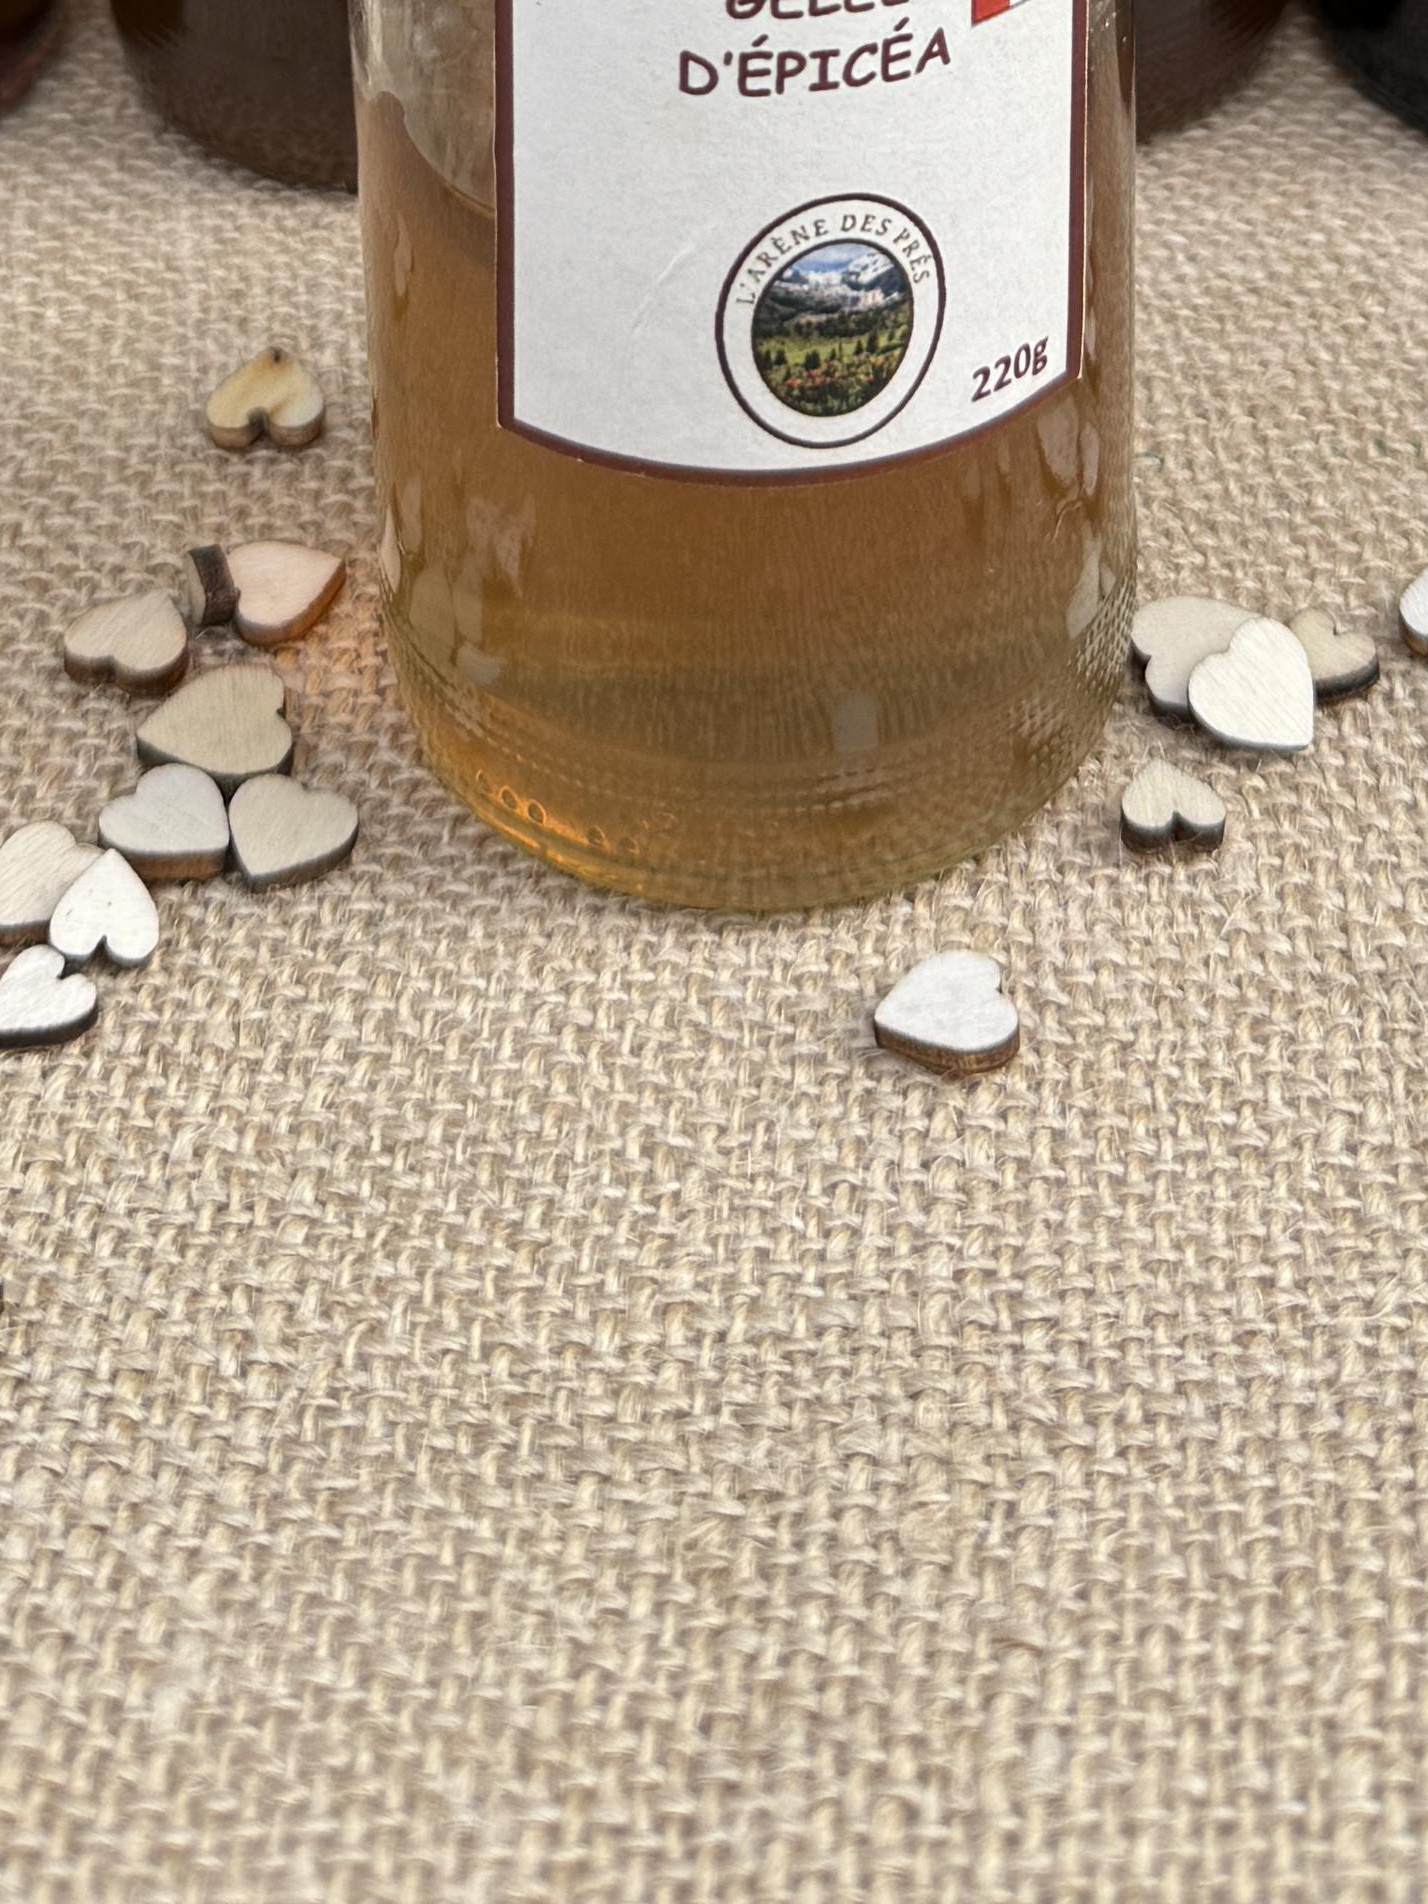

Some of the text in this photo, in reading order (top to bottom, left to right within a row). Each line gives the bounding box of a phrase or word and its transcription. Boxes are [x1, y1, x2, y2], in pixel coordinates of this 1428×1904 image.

[678, 18, 951, 97] D'ÉPICÉA
[737, 214, 933, 305] L'ARÈNE DES PRÉS
[971, 335, 1050, 402] 220g
